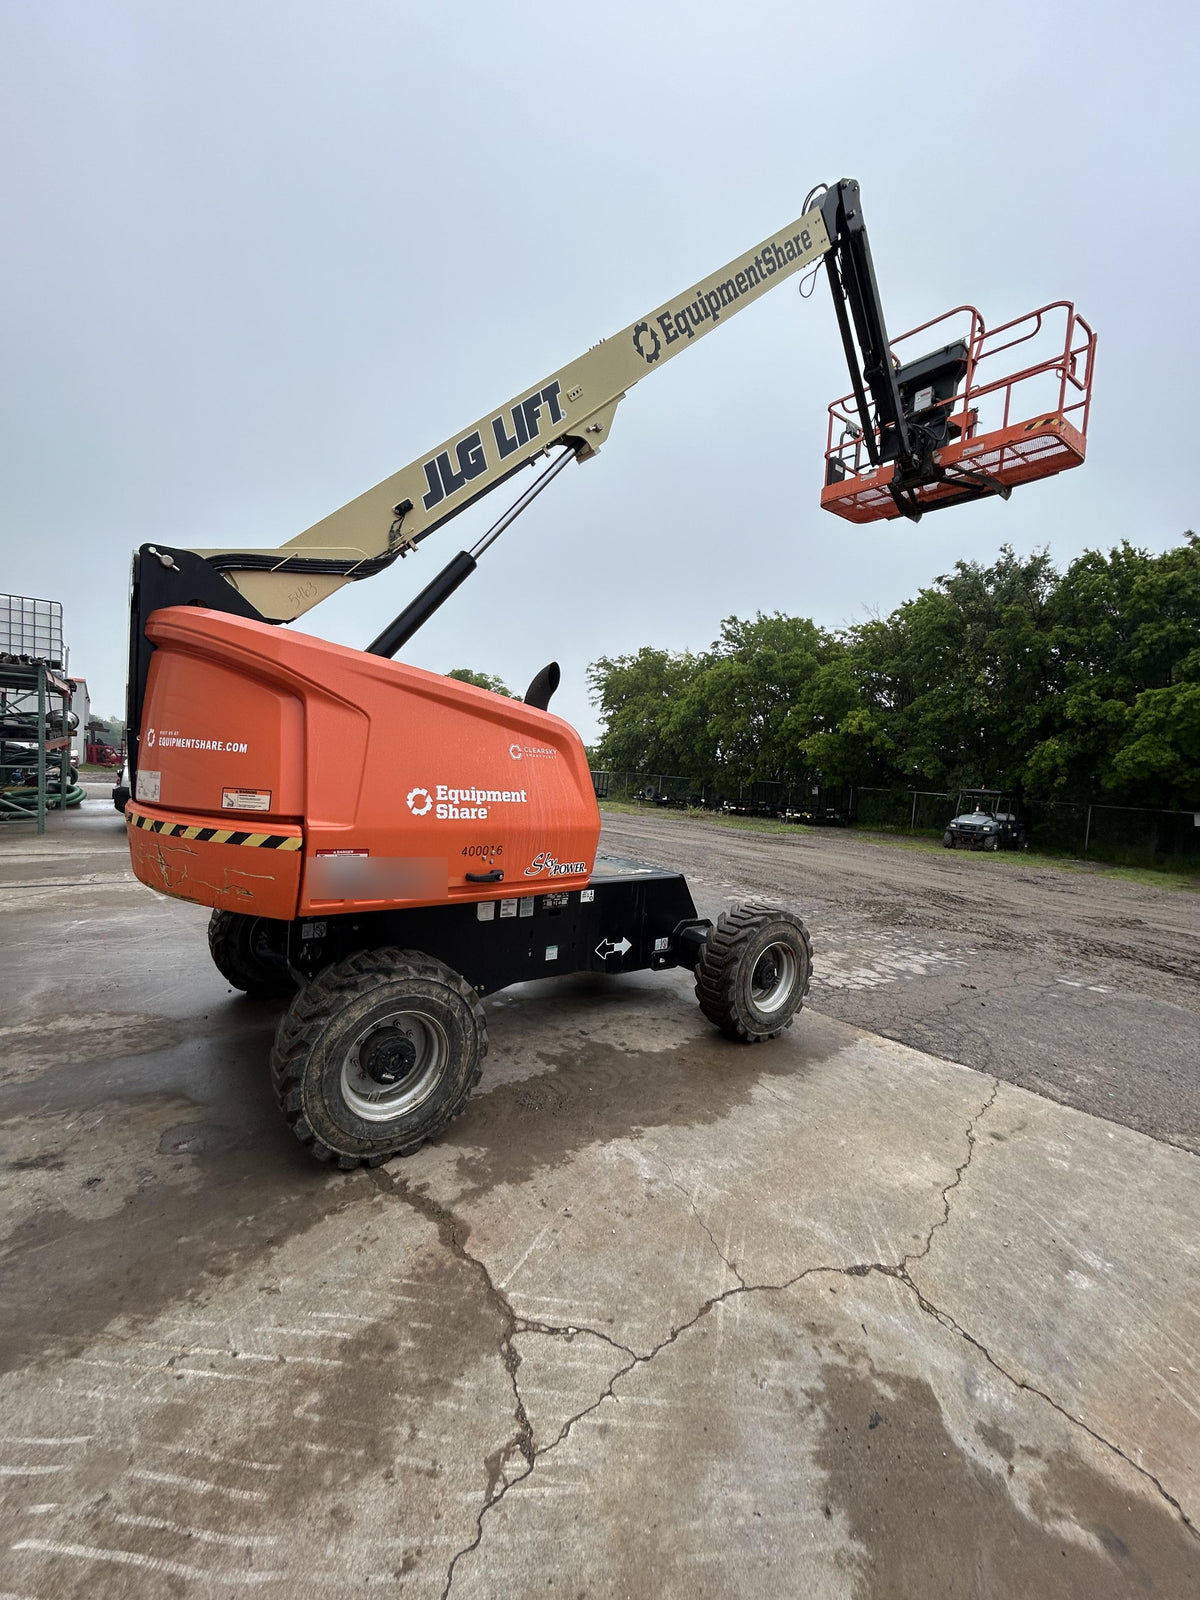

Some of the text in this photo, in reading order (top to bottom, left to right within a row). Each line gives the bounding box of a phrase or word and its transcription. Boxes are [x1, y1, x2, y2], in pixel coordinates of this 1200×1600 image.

[656, 228, 813, 345] EquipmentShare
[422, 380, 563, 511] JLG LIFT
[159, 737, 248, 753] EQUIPMENTSHARE.COM
[436, 785, 527, 805] Equipment
[436, 804, 487, 819] Share
[524, 851, 586, 877] Sky POWER
